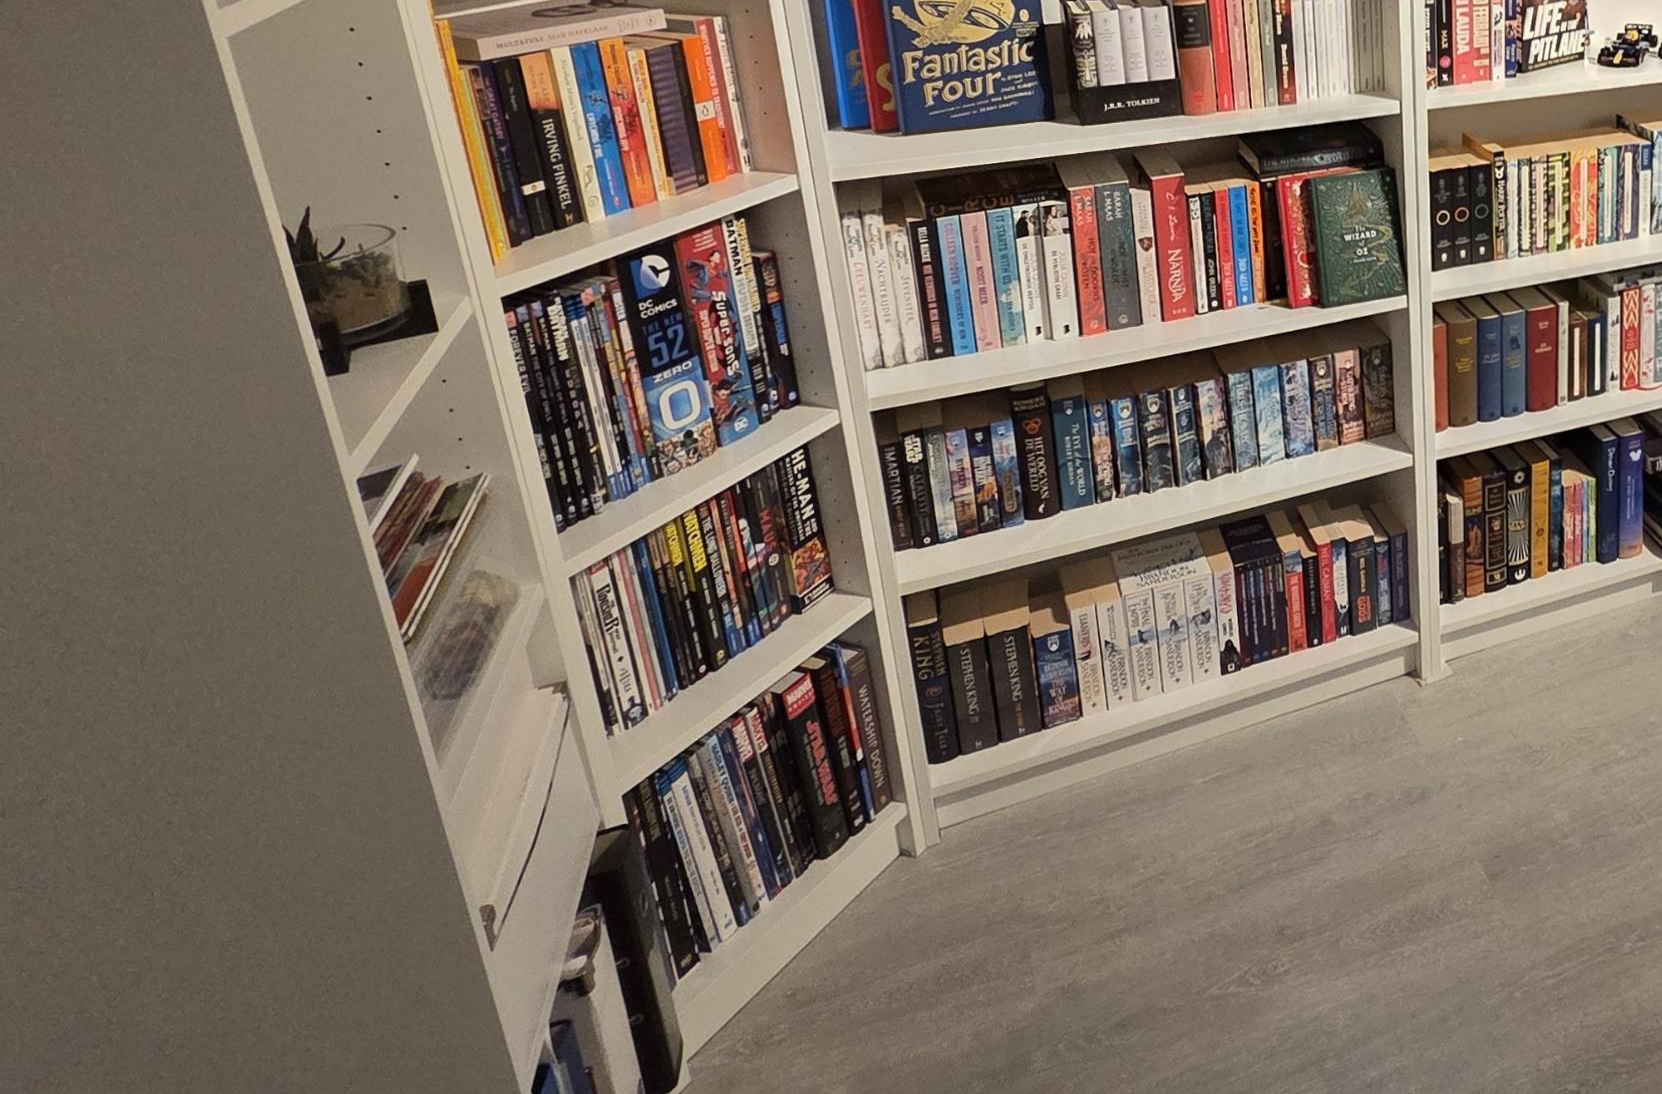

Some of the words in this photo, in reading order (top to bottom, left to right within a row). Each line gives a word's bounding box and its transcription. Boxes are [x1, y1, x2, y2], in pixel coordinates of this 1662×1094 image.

[1441, 30, 1449, 50] MAX
[1456, 6, 1471, 55] LAUDA
[1523, 1, 1567, 41] LIFE
[901, 38, 1035, 86] Fantastic
[1529, 29, 1586, 64] PITLANE
[1126, 97, 1161, 109] TOLKIEN
[542, 118, 563, 163] IRVING
[552, 161, 573, 210] FINKEL
[724, 219, 743, 276] BATMAN
[1343, 230, 1377, 242] WIZARD
[1356, 247, 1369, 256] OZ
[1168, 248, 1186, 303] NARNIA
[638, 298, 654, 312] DC
[640, 298, 678, 319] COMICS
[509, 329, 526, 370] FOREVER
[523, 321, 537, 356] BATMAN
[647, 323, 691, 368] 52
[652, 360, 693, 384] ZERO
[791, 449, 815, 521] HE-MAN
[1076, 467, 1087, 496] WORLD
[913, 636, 934, 681] KING
[931, 630, 947, 677] STEPHEN
[960, 648, 975, 690] STEPHEN
[1003, 635, 1019, 677] STEPHEN
[966, 690, 980, 715] KING
[1010, 677, 1023, 702] KING
[806, 720, 826, 758] STAR
[858, 684, 878, 748] WATERSHIP
[870, 749, 885, 789] DOWN
